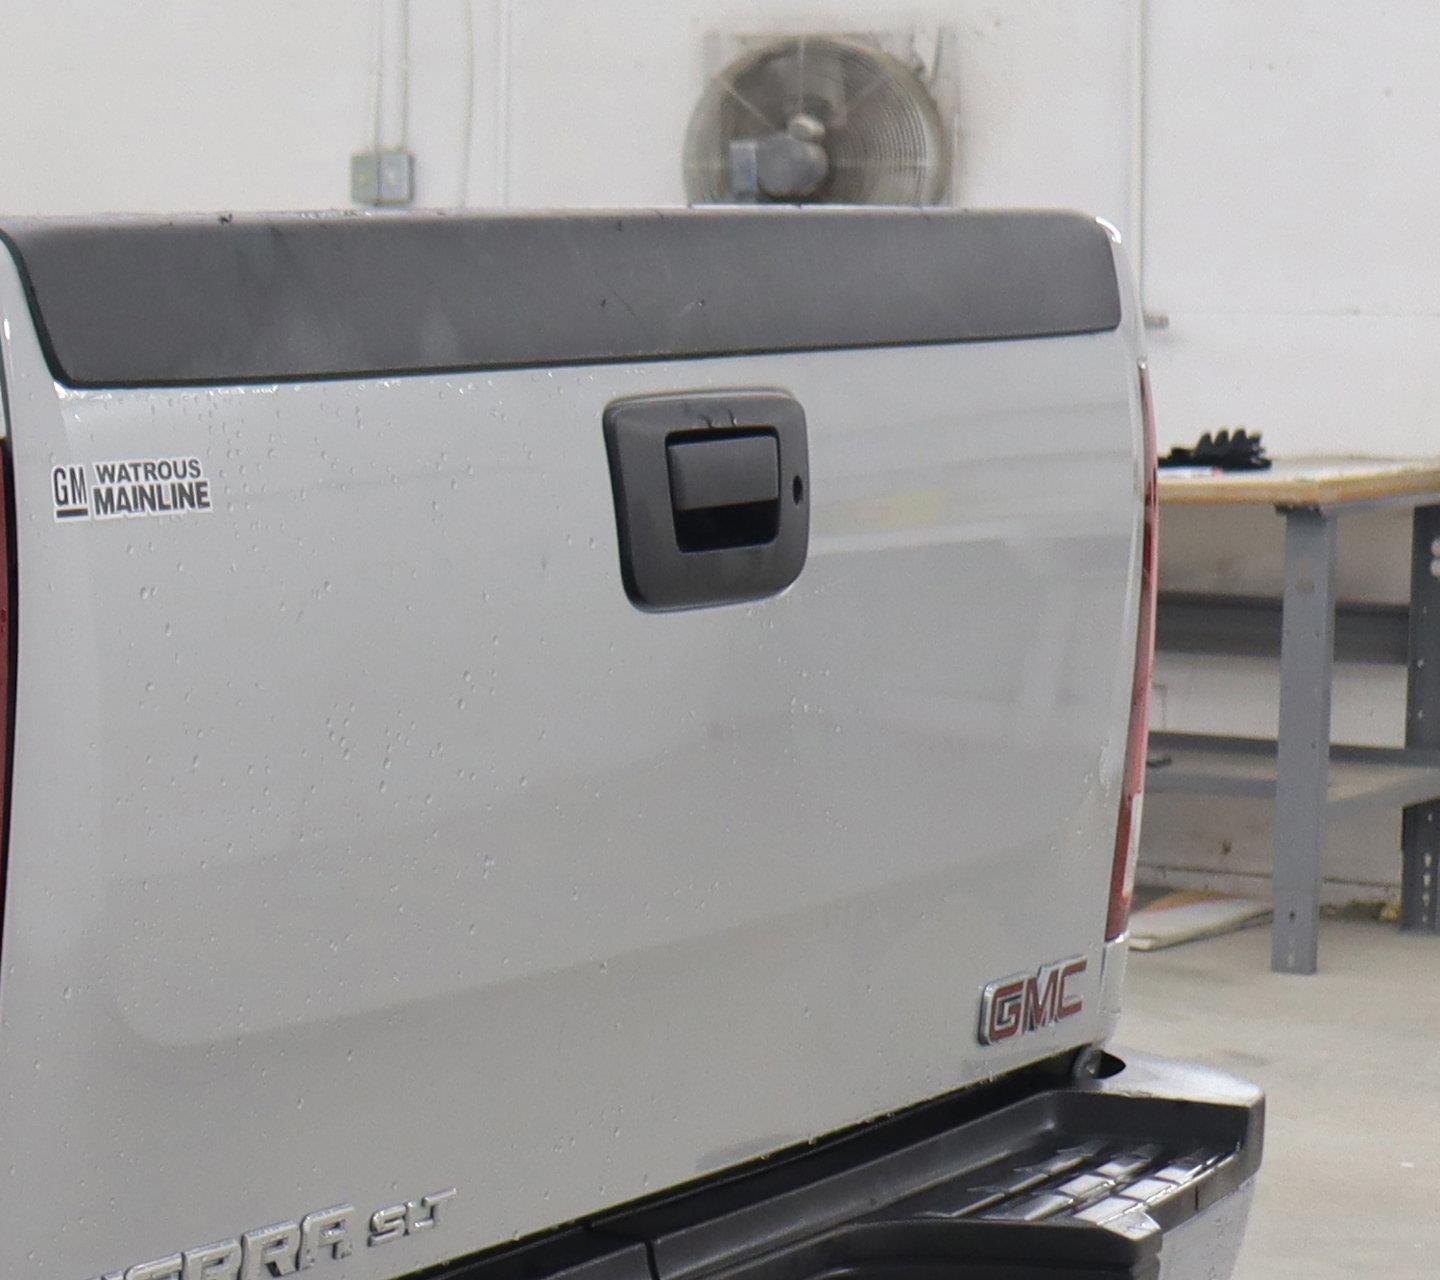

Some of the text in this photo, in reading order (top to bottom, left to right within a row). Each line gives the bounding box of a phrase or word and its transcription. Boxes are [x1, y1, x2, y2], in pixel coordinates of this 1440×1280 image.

[53, 466, 88, 507] GM
[95, 459, 202, 485] WATROUS
[93, 481, 211, 516] MAINLINE
[978, 954, 1088, 1046] GMC
[367, 1186, 457, 1247] SLT
